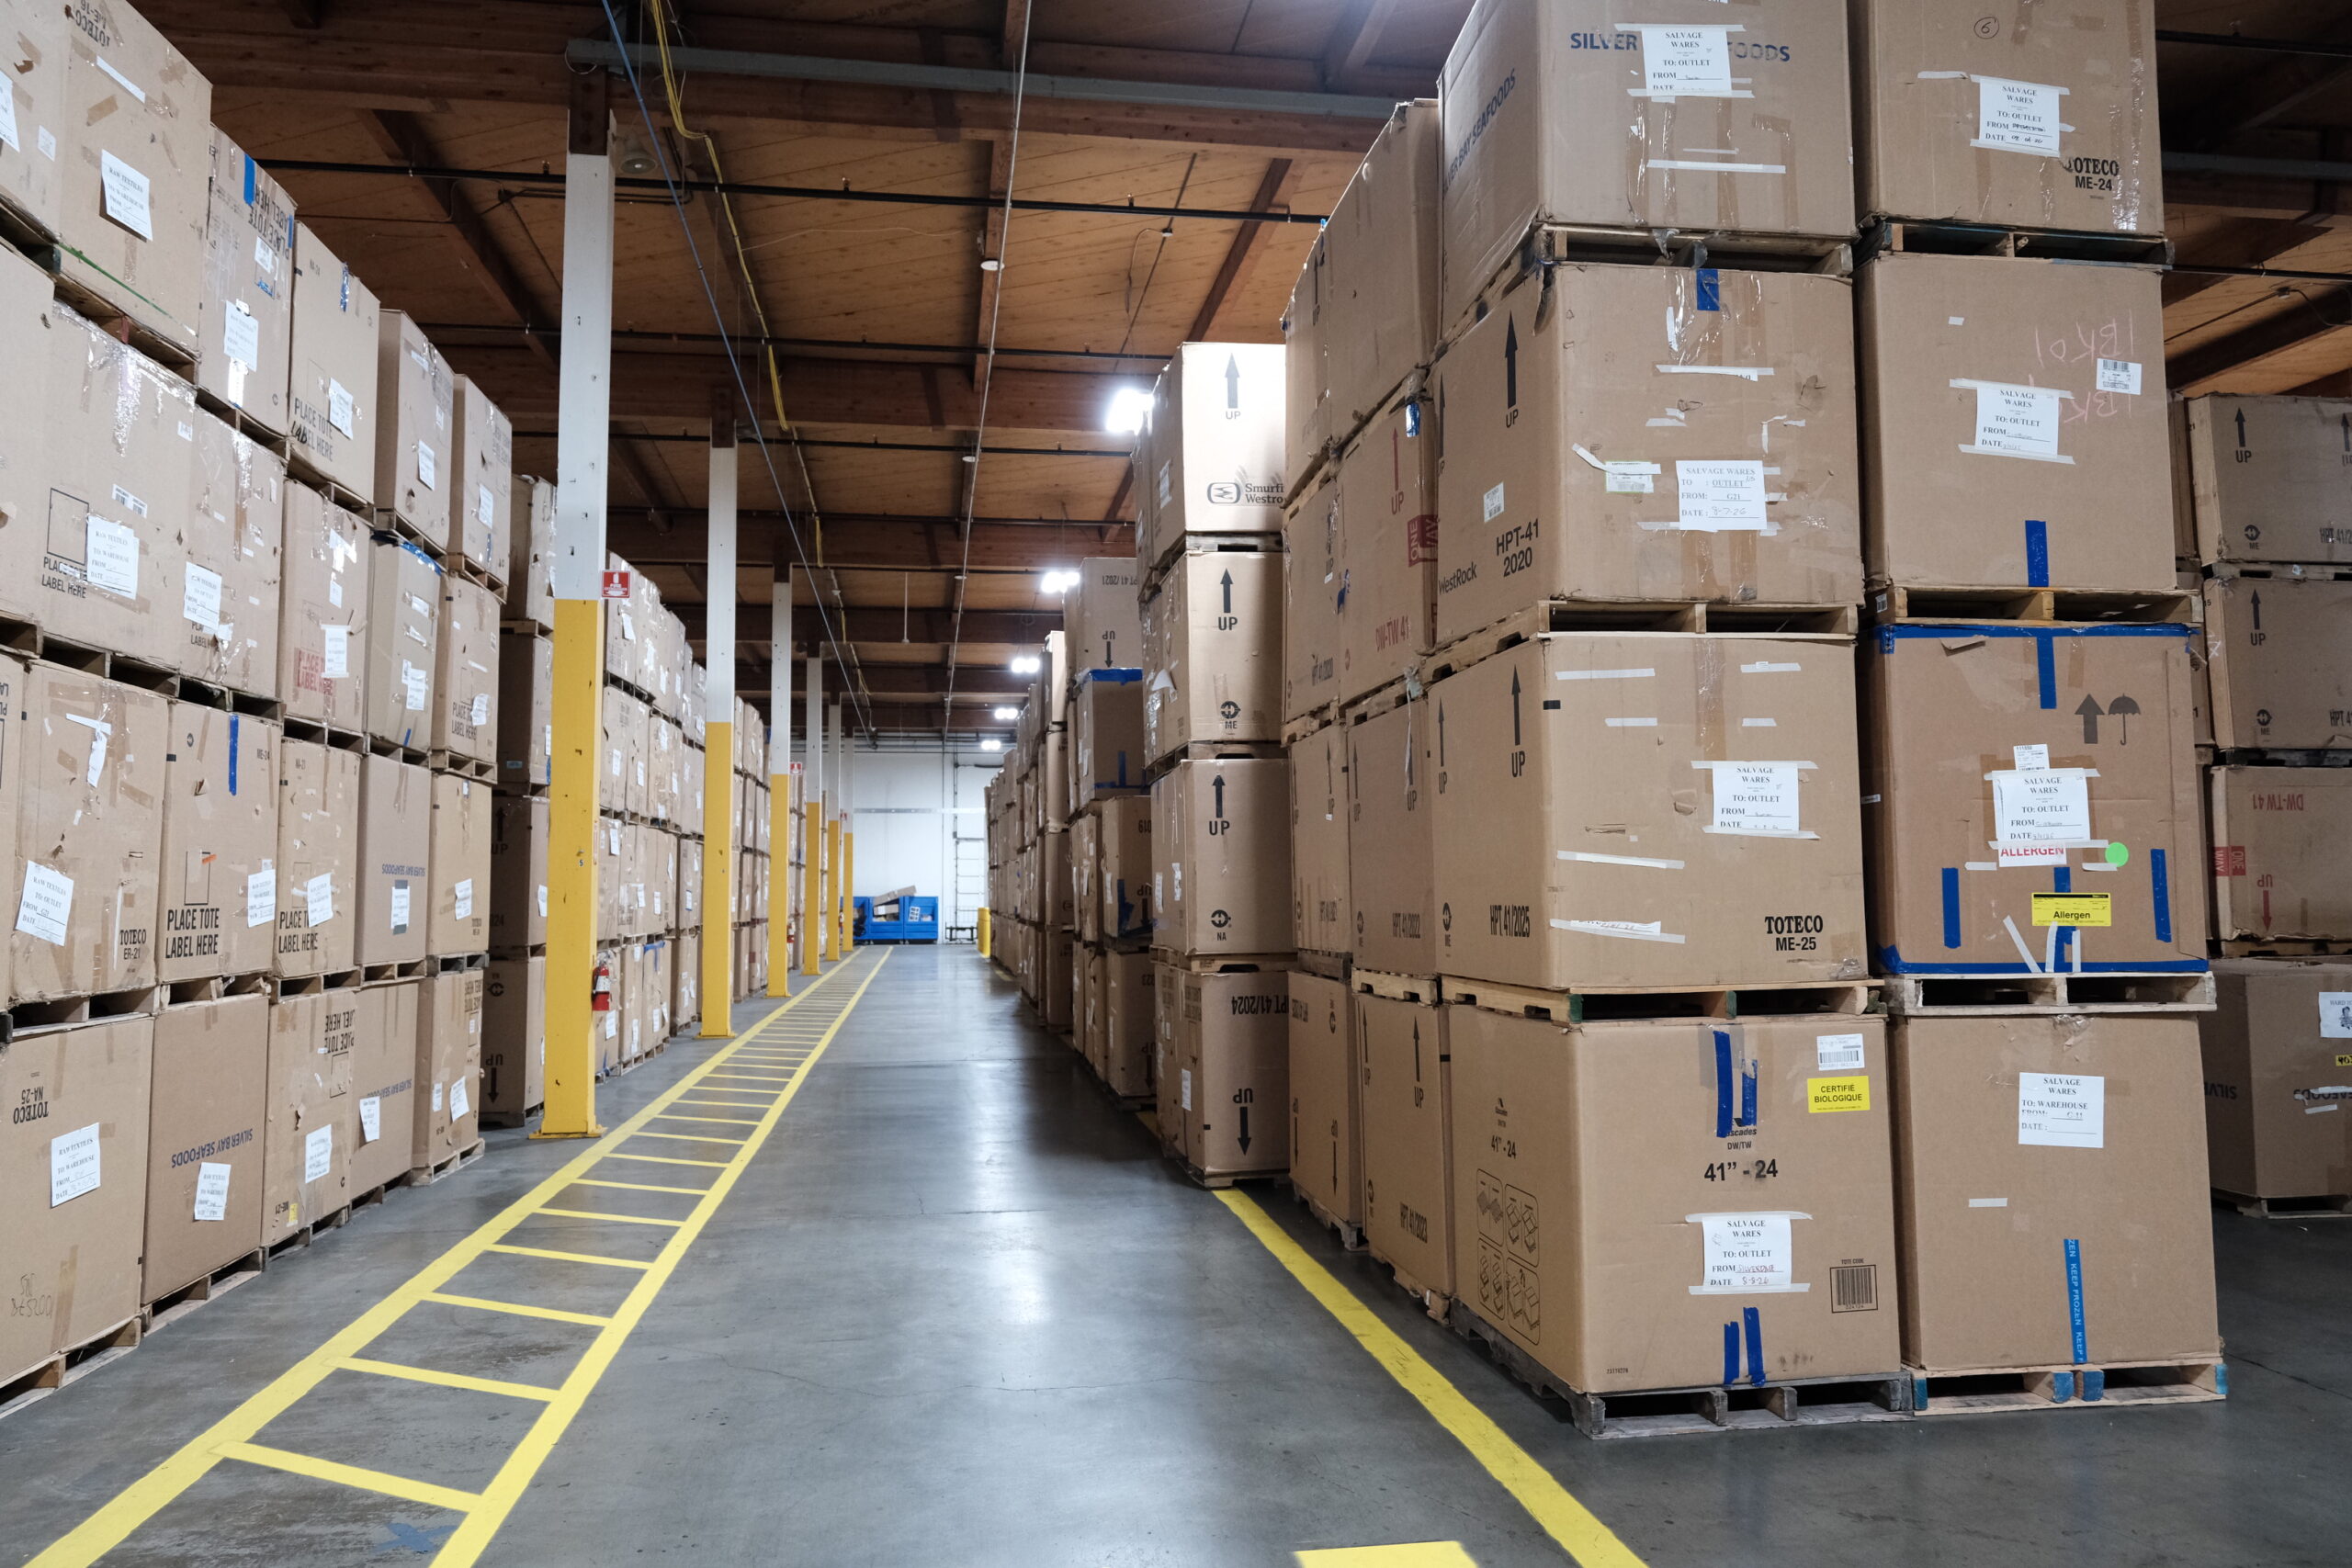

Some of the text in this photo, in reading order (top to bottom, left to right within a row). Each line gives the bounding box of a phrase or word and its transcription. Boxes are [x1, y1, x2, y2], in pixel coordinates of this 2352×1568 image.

[1570, 32, 1637, 51] SILVER
[1678, 59, 1710, 67] OUTLET
[2002, 85, 2038, 96] SALVAGE
[2007, 95, 2033, 104] WARES
[1458, 68, 1516, 168] BAY SEAFOODS
[1997, 110, 2042, 123] TO: OUTLET
[1986, 120, 2009, 130] FROM
[1985, 132, 2006, 141] DATE
[2075, 175, 2113, 191] ME-24
[2000, 389, 2036, 400] SALVAGE
[2005, 399, 2032, 408] WARES
[295, 398, 316, 426] PLACE
[318, 413, 333, 440] TOTE
[1226, 412, 1240, 420] UP
[1506, 409, 1519, 429] UP
[1996, 415, 2041, 427] TO: OUTLET
[1983, 426, 2007, 435] FROM
[317, 435, 333, 461] HERE
[1982, 439, 2002, 447] DATE
[2235, 450, 2252, 463] UP
[1245, 483, 1284, 493] Smurfi
[1245, 494, 1283, 503] Westro
[1391, 492, 1404, 515] UP
[1496, 518, 1539, 557] HPT-41
[92, 560, 106, 569] FROM
[1503, 547, 1532, 577] 2020
[1439, 561, 1477, 595] WestRock
[42, 574, 86, 598] LABEL HERE
[1218, 616, 1238, 631] UP
[1102, 631, 1115, 640] UP
[2251, 633, 2266, 646] UP
[1225, 721, 1238, 729] ME
[1511, 750, 1526, 778] UP
[1439, 772, 1448, 795] UP
[1408, 791, 1417, 811] UP
[2253, 794, 2304, 811] DW-TW 41
[2038, 805, 2069, 813] OUTLET
[1209, 821, 1230, 836] UP
[2000, 847, 2064, 857] ALLERGEN
[2232, 851, 2245, 872] ONE
[2256, 874, 2273, 887] UP
[46, 880, 66, 896] TEXTILES
[23, 901, 38, 912] FROM
[22, 914, 35, 924] DATE
[167, 908, 220, 931] PLACE TOTE
[279, 910, 301, 930] PLACE
[1489, 905, 1531, 938] HPT 41/2025
[2053, 911, 2091, 920] Allergen
[1765, 915, 1823, 934] TOTECO
[119, 929, 147, 946] TOTECO
[278, 932, 319, 953] LABEL HERE
[1216, 932, 1227, 942] NA
[165, 934, 219, 958] LABEL HERE
[1776, 937, 1816, 951] ME-25
[123, 948, 141, 960] ER-21
[485, 1054, 503, 1066] UP
[2043, 1077, 2081, 1086] SALVAGE
[20, 1086, 44, 1105] NA-25
[1233, 1089, 1253, 1103] UP
[1414, 1087, 1424, 1109] UP
[1814, 1093, 1863, 1103] BIOLOGIQUE
[2037, 1100, 2088, 1110] WAREHOUSE
[13, 1100, 49, 1125] TOTECO
[172, 1128, 253, 1168] SILVER BAY SEAFOODS
[1508, 1139, 1516, 1159] 24
[1727, 1141, 1752, 1150] DW/TW
[1755, 1158, 1778, 1179] 24
[56, 1177, 71, 1188] FROM
[55, 1190, 68, 1200] DATE
[1727, 1220, 1766, 1228] SALVAGE
[1733, 1230, 1761, 1238] WARES
[1738, 1250, 1771, 1258] OUTLET
[1712, 1264, 1736, 1272] FROM
[2071, 1263, 2079, 1287] KEEP
[2073, 1289, 2081, 1325] FROZEN
[2075, 1331, 2084, 1355] KEEP
